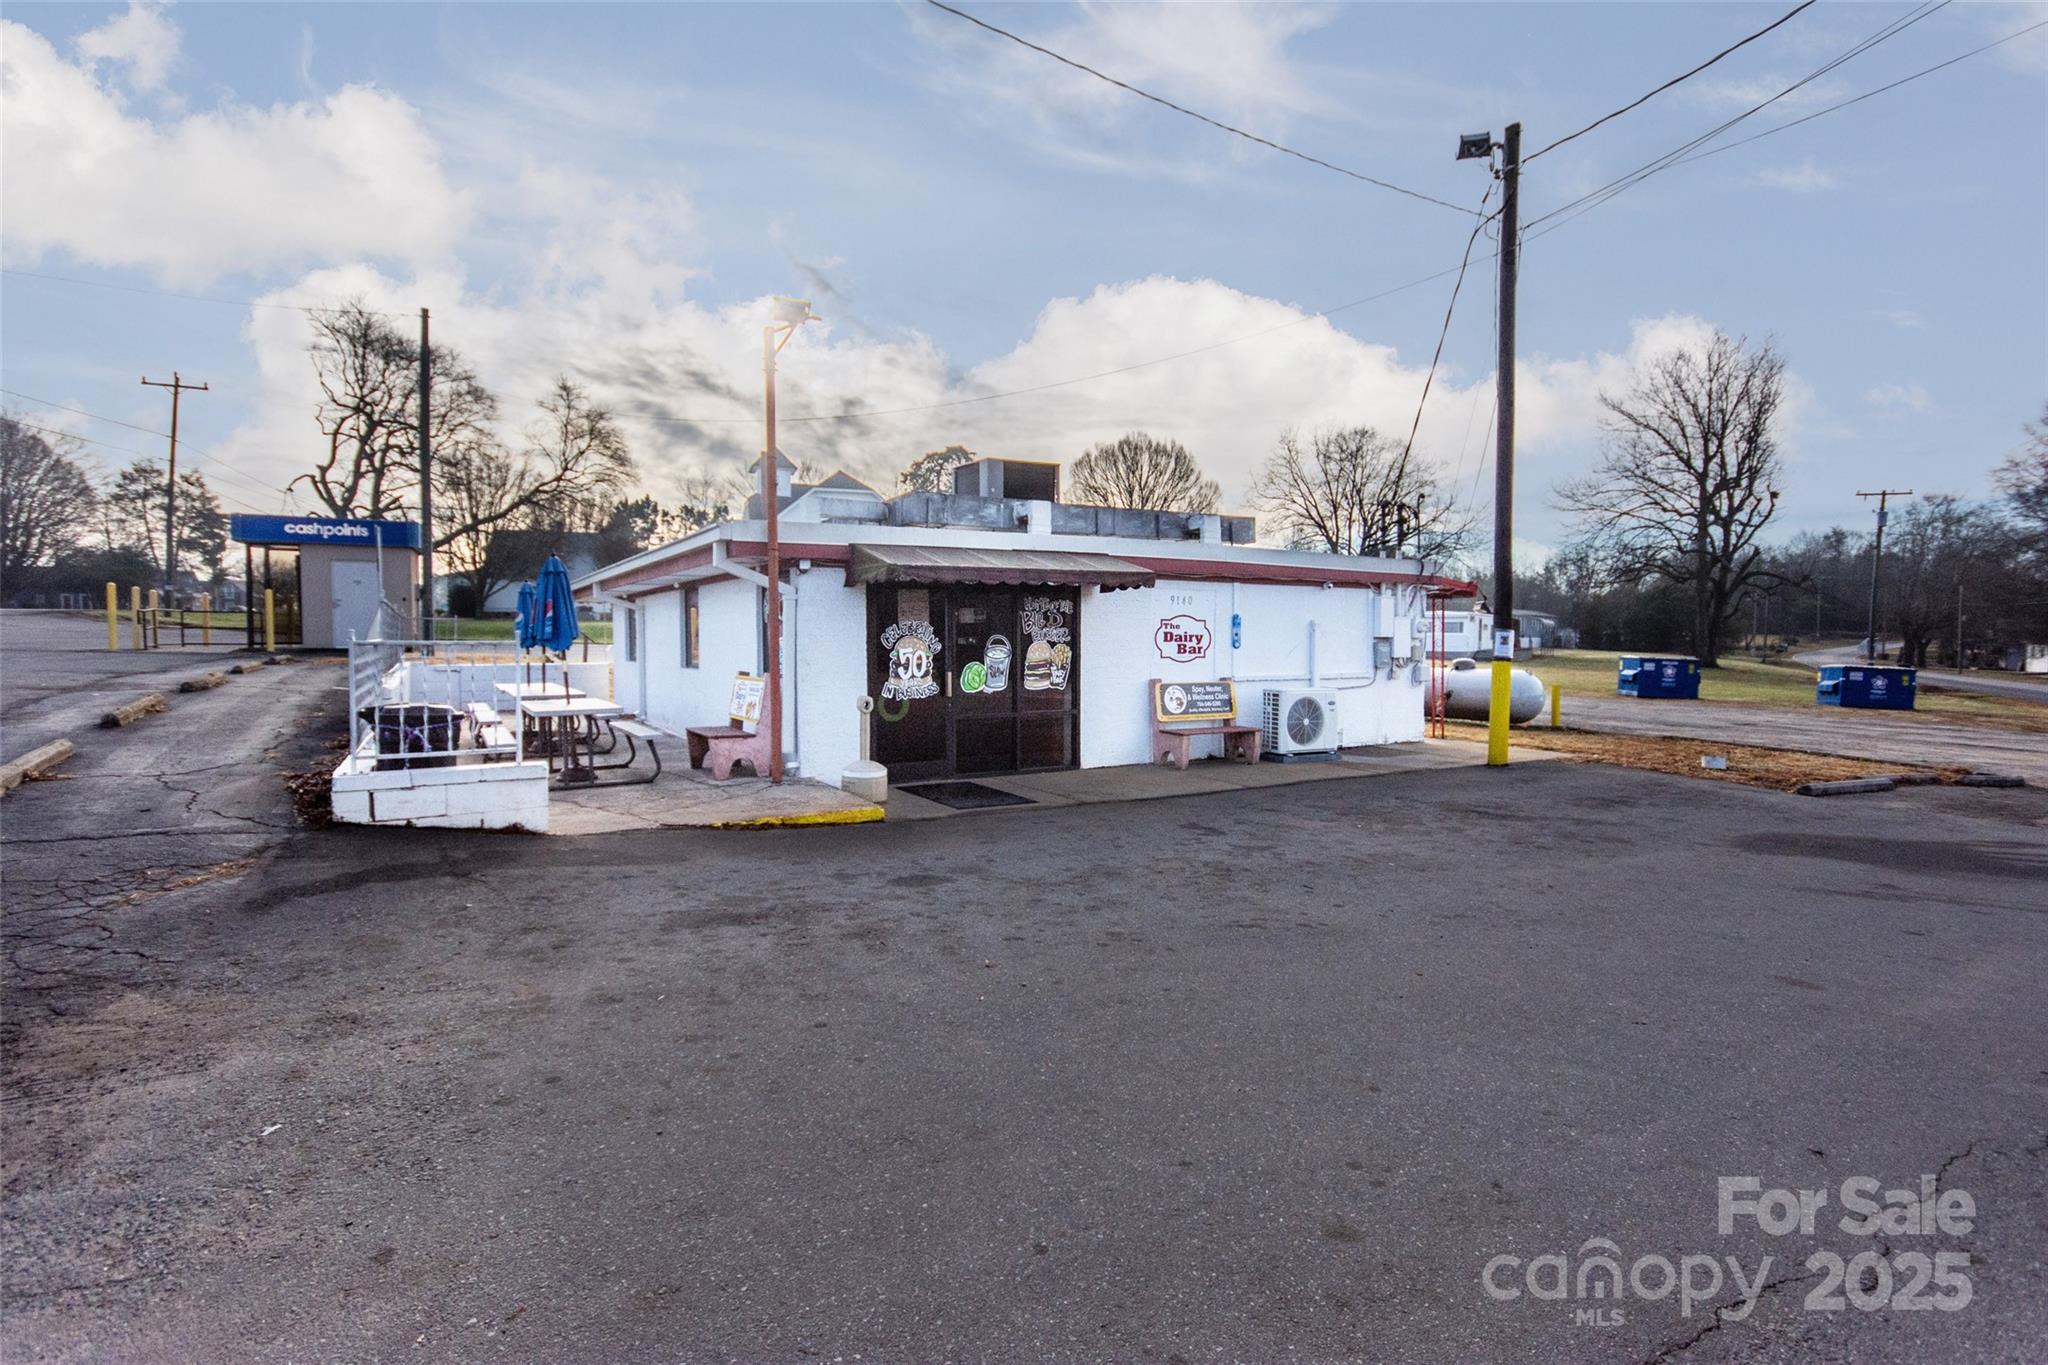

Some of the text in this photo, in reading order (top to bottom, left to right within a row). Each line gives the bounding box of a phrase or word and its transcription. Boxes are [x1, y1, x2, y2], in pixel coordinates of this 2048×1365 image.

[283, 522, 369, 539] cashpoints
[1019, 609, 1063, 634] BIG D
[1163, 622, 1180, 630] The
[881, 620, 942, 655] CELEBRATING
[1163, 631, 1204, 645] Dairy
[1177, 643, 1203, 655] Bar
[897, 647, 928, 680] 50
[881, 681, 940, 701] IN BUSINESS
